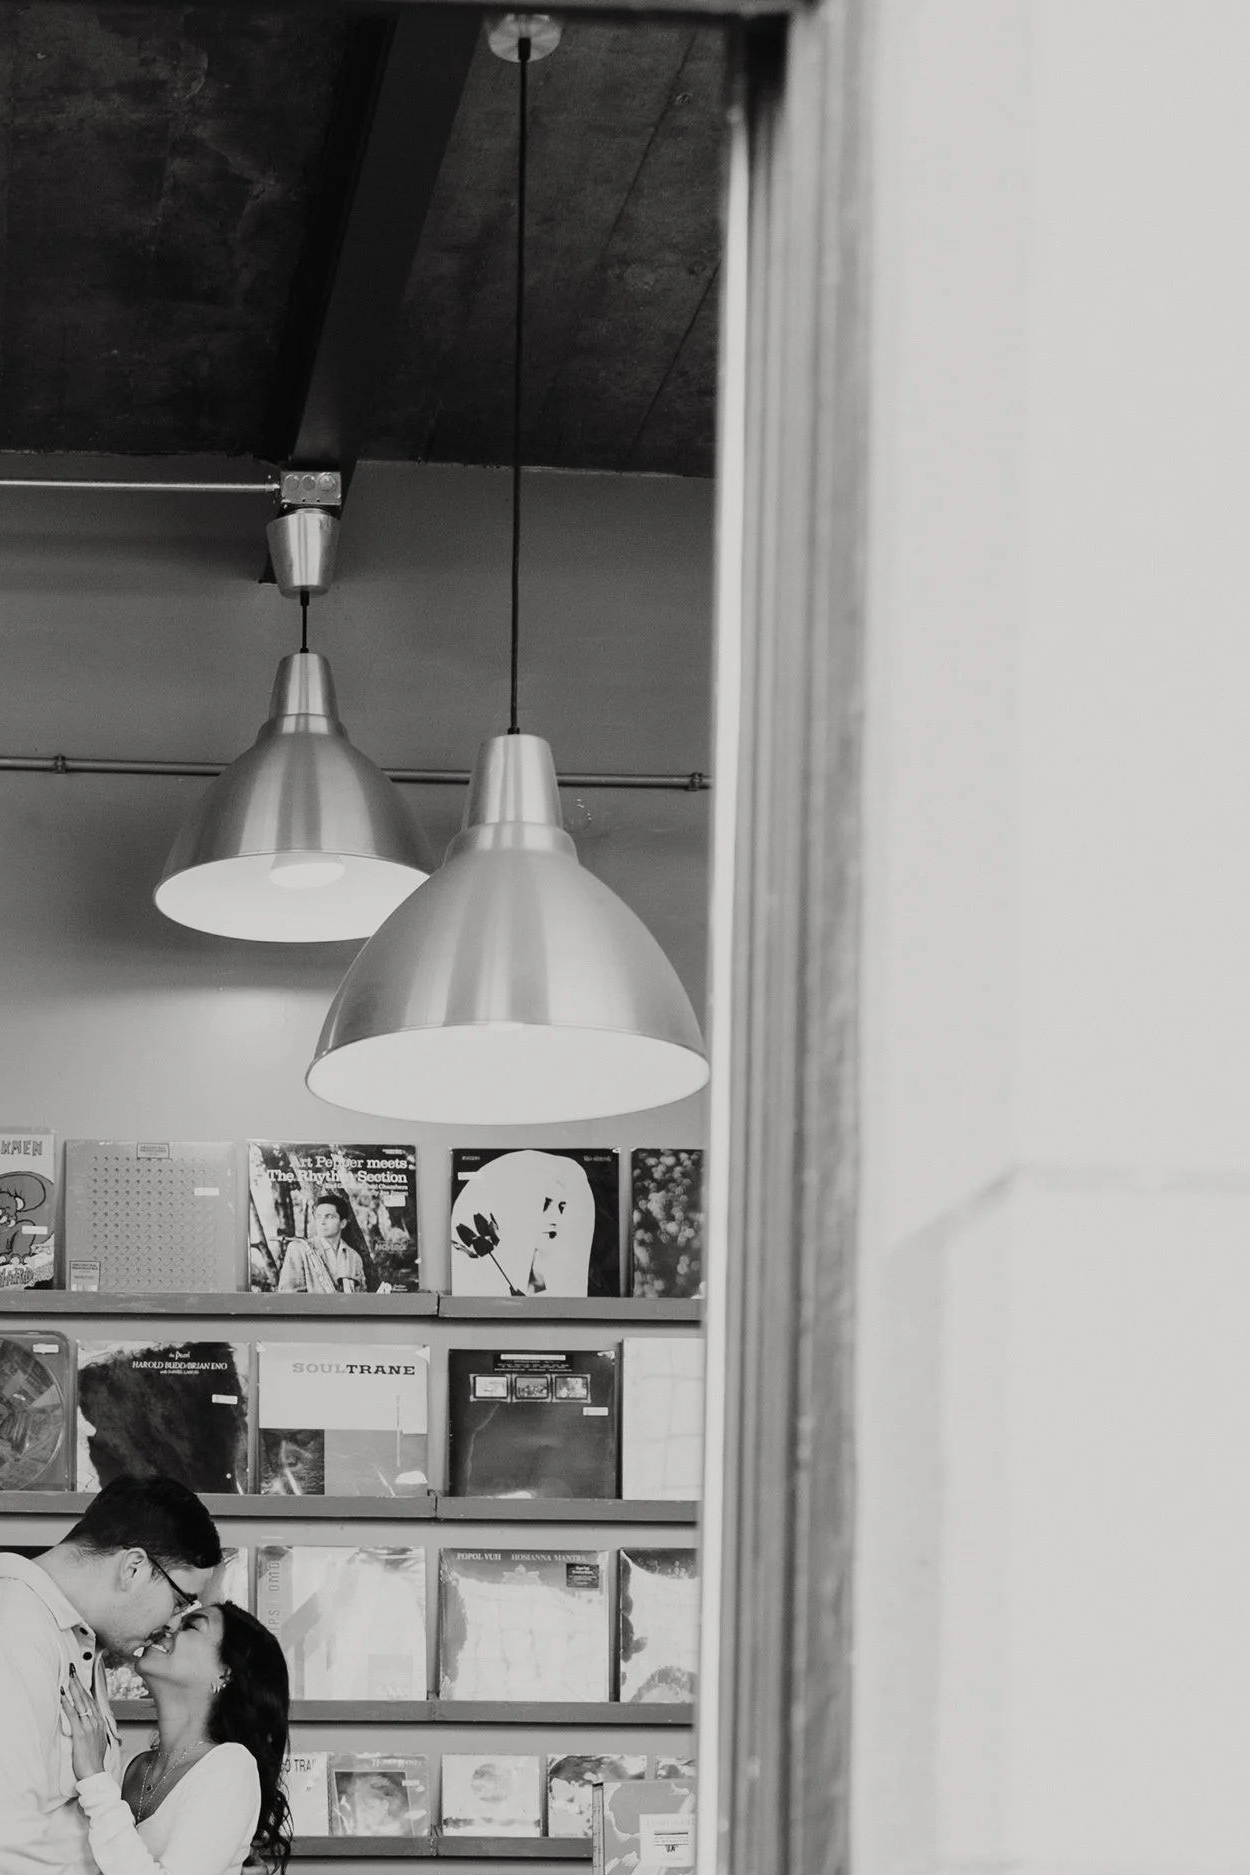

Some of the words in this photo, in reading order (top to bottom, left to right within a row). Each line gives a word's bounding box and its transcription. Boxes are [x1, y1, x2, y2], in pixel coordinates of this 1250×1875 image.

[290, 1156, 313, 1168] Art
[315, 1156, 364, 1169] Pepper
[366, 1157, 408, 1169] meets
[267, 1170, 295, 1182] The
[299, 1170, 344, 1185] Rhyth
[357, 1171, 408, 1183] Section
[132, 1361, 163, 1369] HAROLD
[211, 1362, 228, 1370] ENO
[291, 1362, 416, 1376] SOULTRANE
[268, 1561, 281, 1592] OMD
